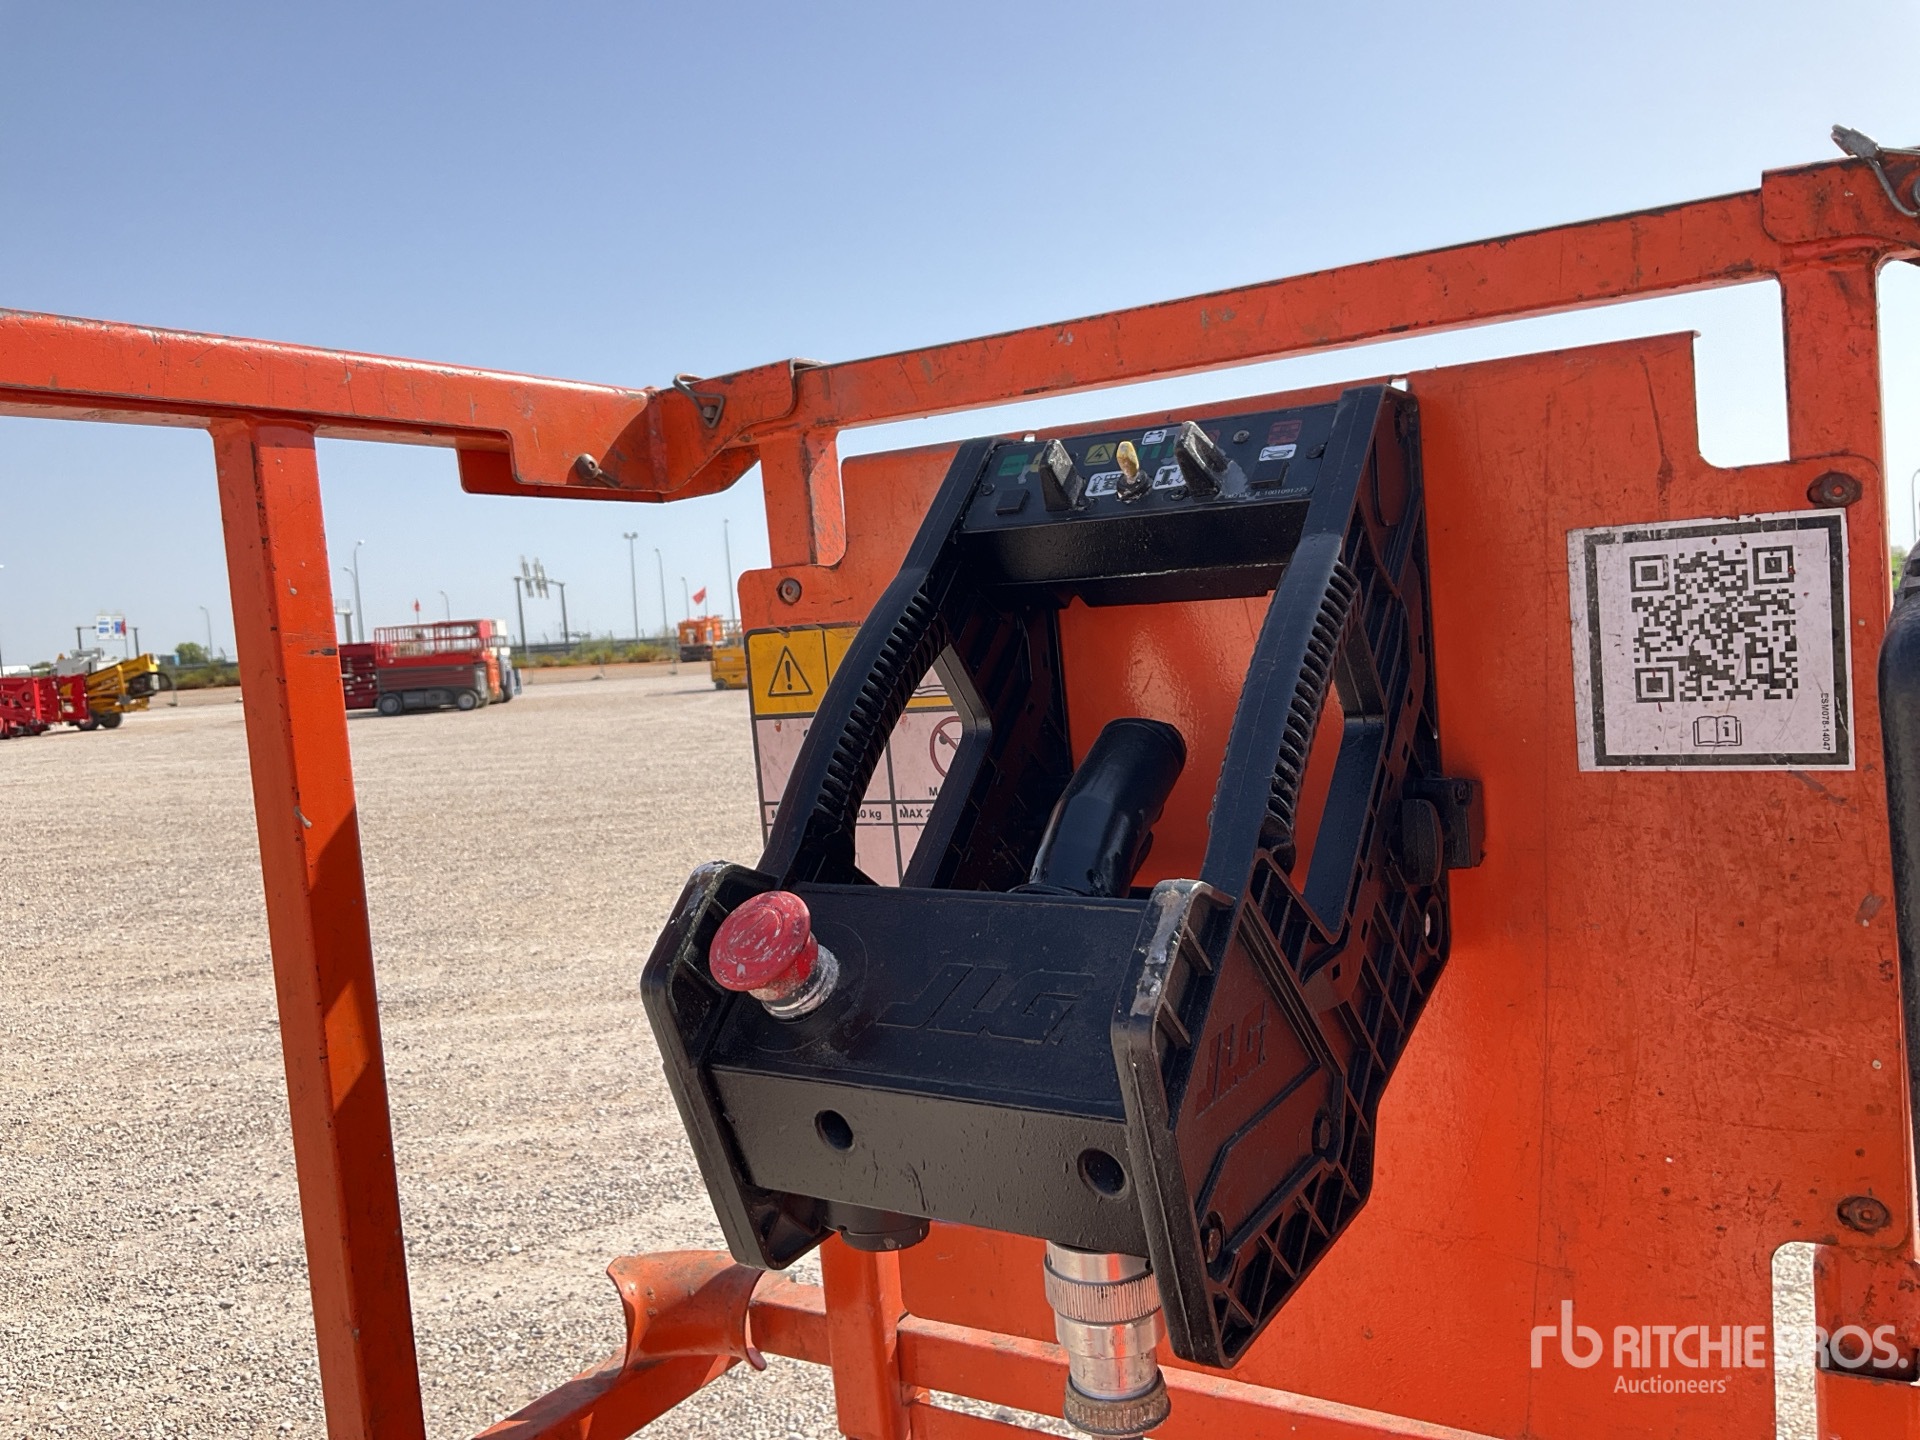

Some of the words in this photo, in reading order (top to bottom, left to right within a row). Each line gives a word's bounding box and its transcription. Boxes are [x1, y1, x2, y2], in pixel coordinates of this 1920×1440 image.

[869, 809, 882, 820] kg
[899, 808, 924, 818] MAX
[875, 962, 1096, 1046] JLG
[1194, 999, 1269, 1119] JLG
